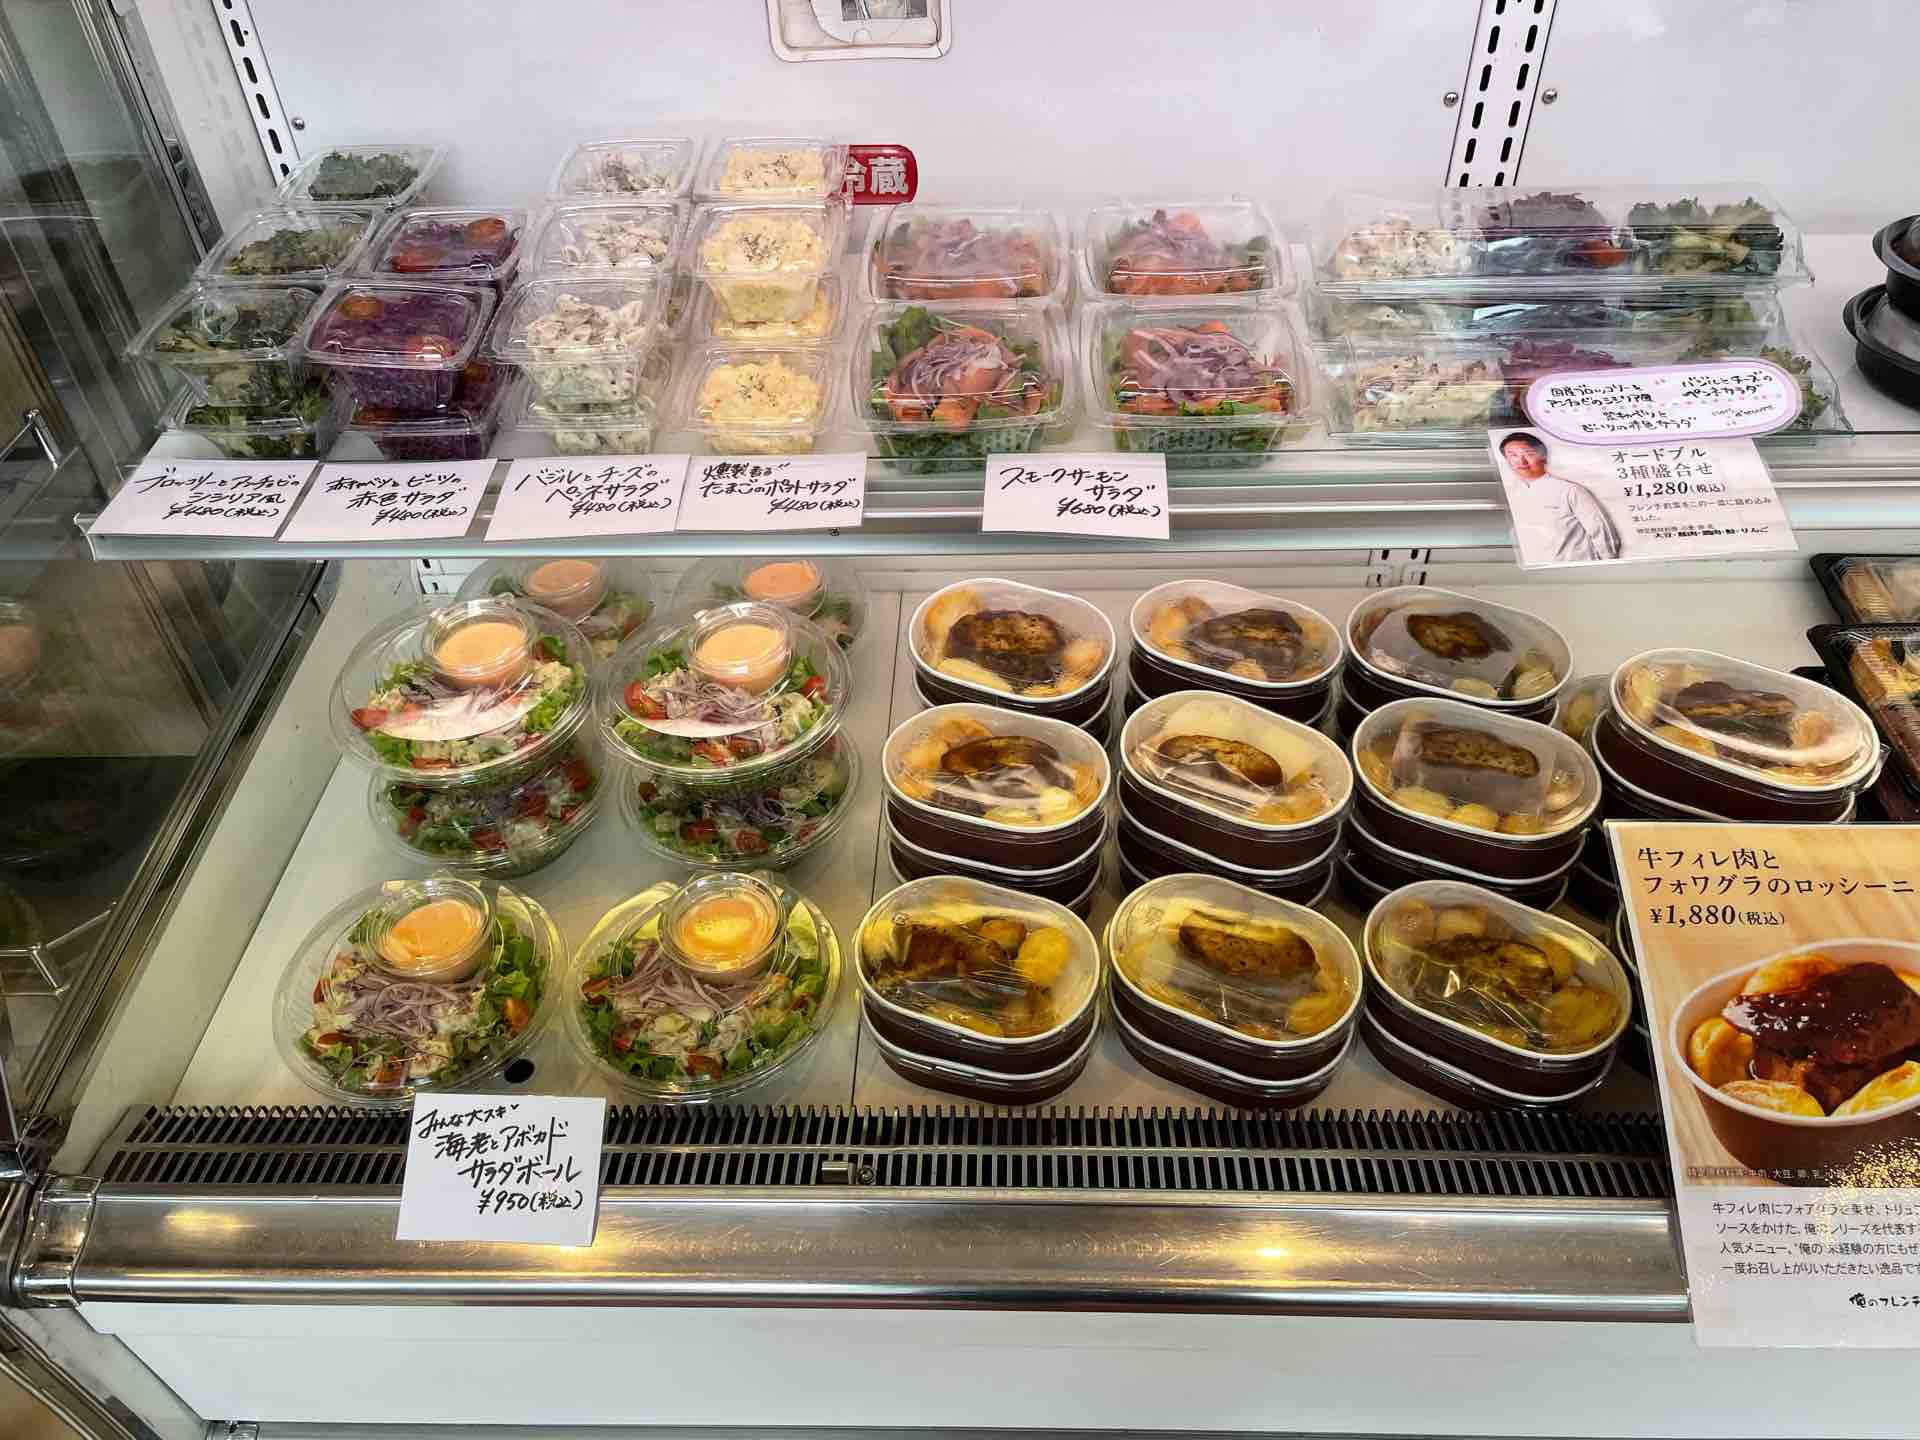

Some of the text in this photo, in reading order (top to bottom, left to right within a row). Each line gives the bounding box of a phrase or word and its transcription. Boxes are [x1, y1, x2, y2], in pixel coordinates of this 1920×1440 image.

[1611, 446, 1707, 464] オードブル
[514, 463, 658, 491] バジルとチーズの
[999, 467, 1129, 490] スモークサーモン
[1617, 461, 1714, 480] 3種盛合せ
[346, 486, 467, 510] 赤色サラダ
[544, 478, 670, 503] ペンネサラダ
[699, 478, 856, 498] たまごのポテトサラダ
[1084, 483, 1156, 501] サラダ
[1637, 846, 1781, 871] 牛フィレ肉と
[1643, 873, 1915, 897] フォワグラのロッシーニ
[1648, 903, 1786, 929] ¥1,880(税込)
[434, 1115, 570, 1166] 海老とアボカド
[457, 1154, 582, 1189] サラダボール
